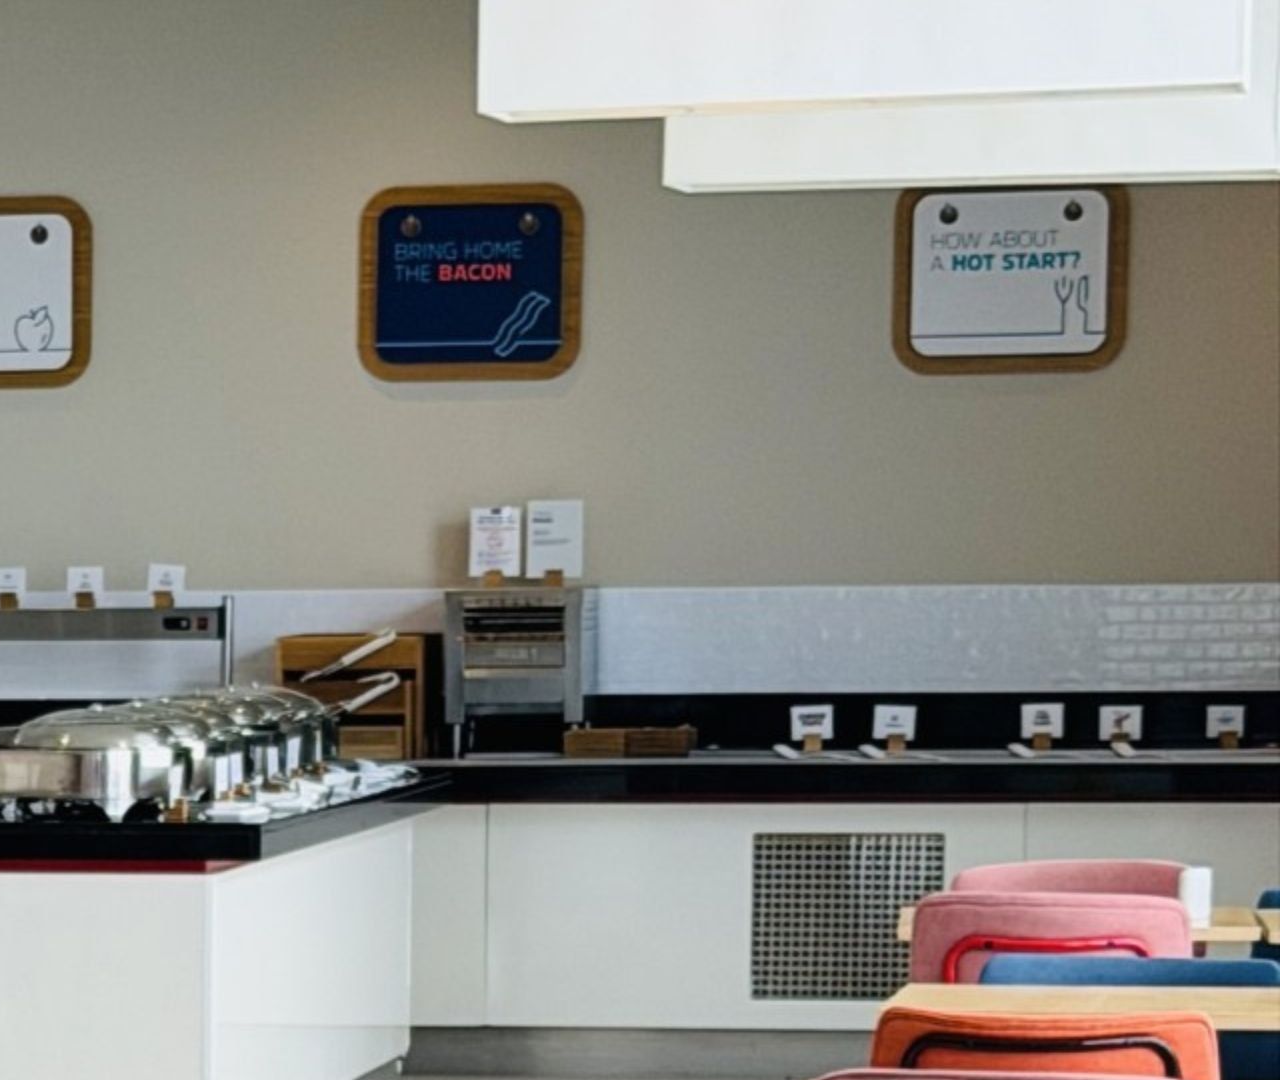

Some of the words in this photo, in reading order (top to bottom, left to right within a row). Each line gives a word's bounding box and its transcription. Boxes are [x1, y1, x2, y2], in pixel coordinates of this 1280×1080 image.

[930, 232, 982, 250] HOW
[989, 229, 1059, 249] ABOUT
[394, 242, 458, 261] BRING
[464, 241, 523, 260] HOME
[930, 255, 945, 272] A
[951, 253, 996, 271] HOT
[1002, 251, 1081, 271] START?
[394, 264, 431, 282] THE
[438, 263, 512, 282] BACON
